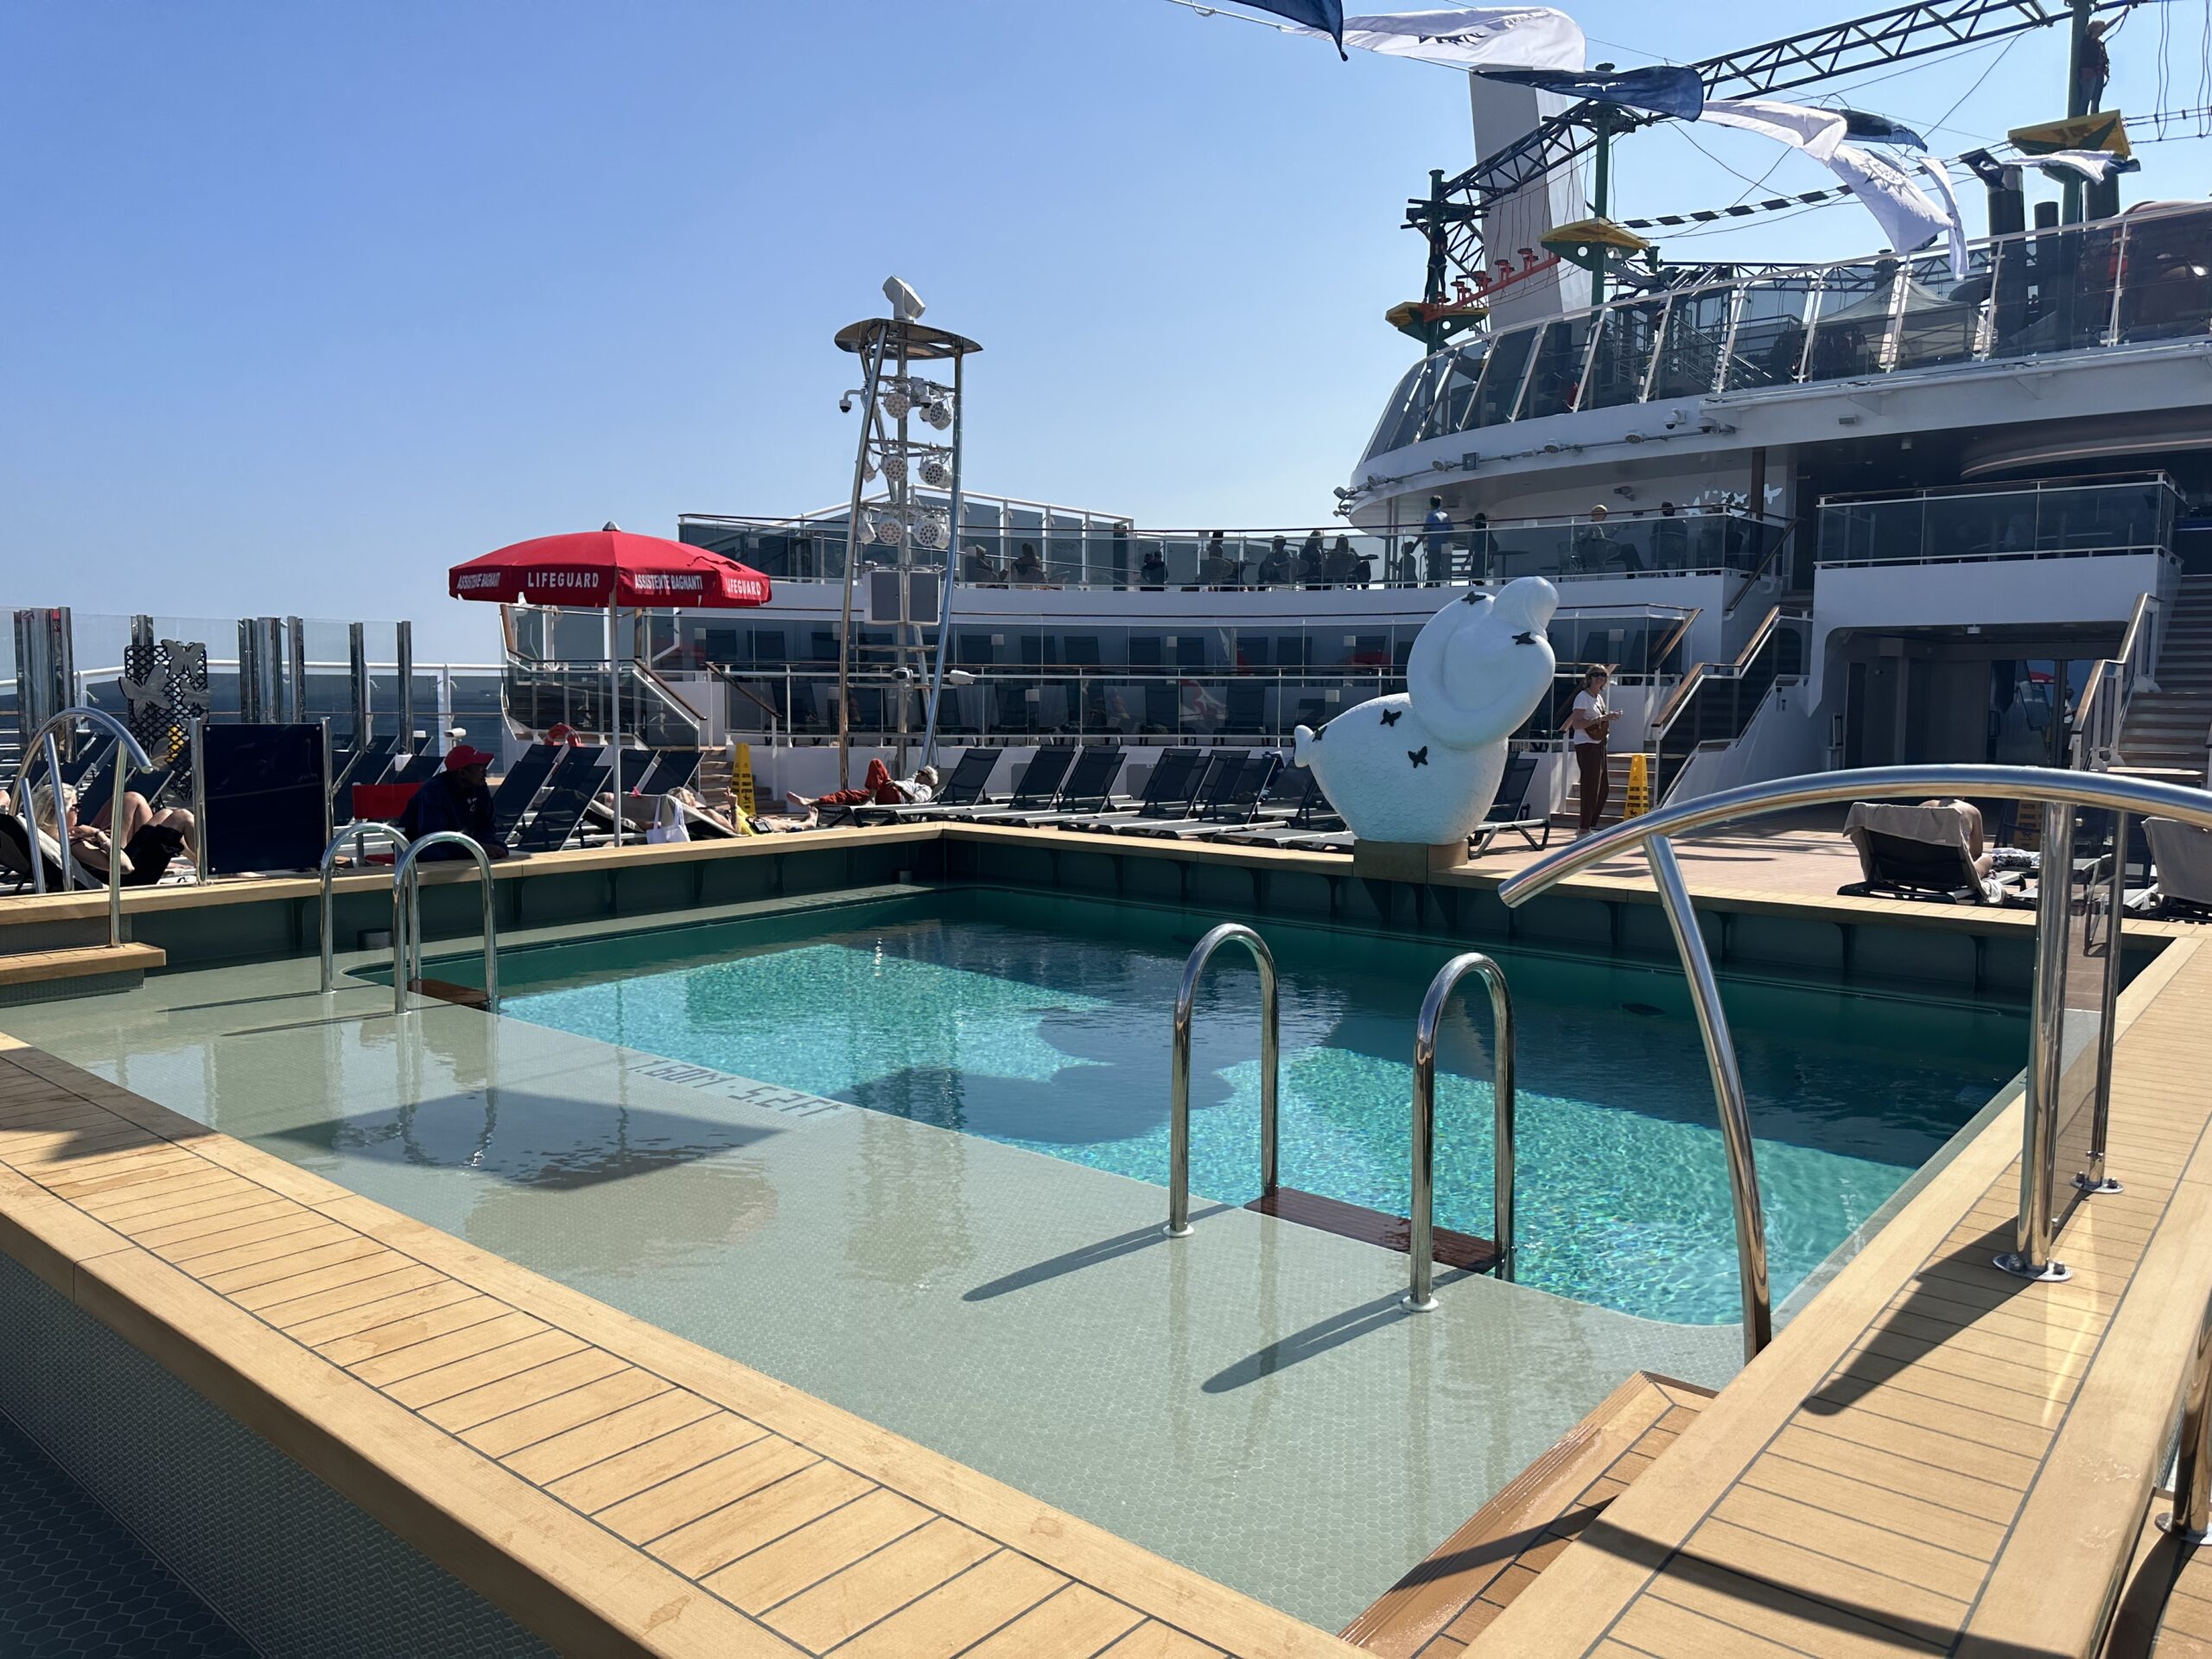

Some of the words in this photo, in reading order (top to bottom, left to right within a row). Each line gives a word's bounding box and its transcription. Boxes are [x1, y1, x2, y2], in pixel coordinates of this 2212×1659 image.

[527, 572, 599, 588] LIFEGUARD
[635, 574, 671, 589] ASSISTENTE
[671, 575, 703, 589] BAGNANTI
[726, 577, 761, 595] LIFEGUARD
[626, 1059, 736, 1088] 1.60M
[727, 1085, 842, 1117] 5.2FT
